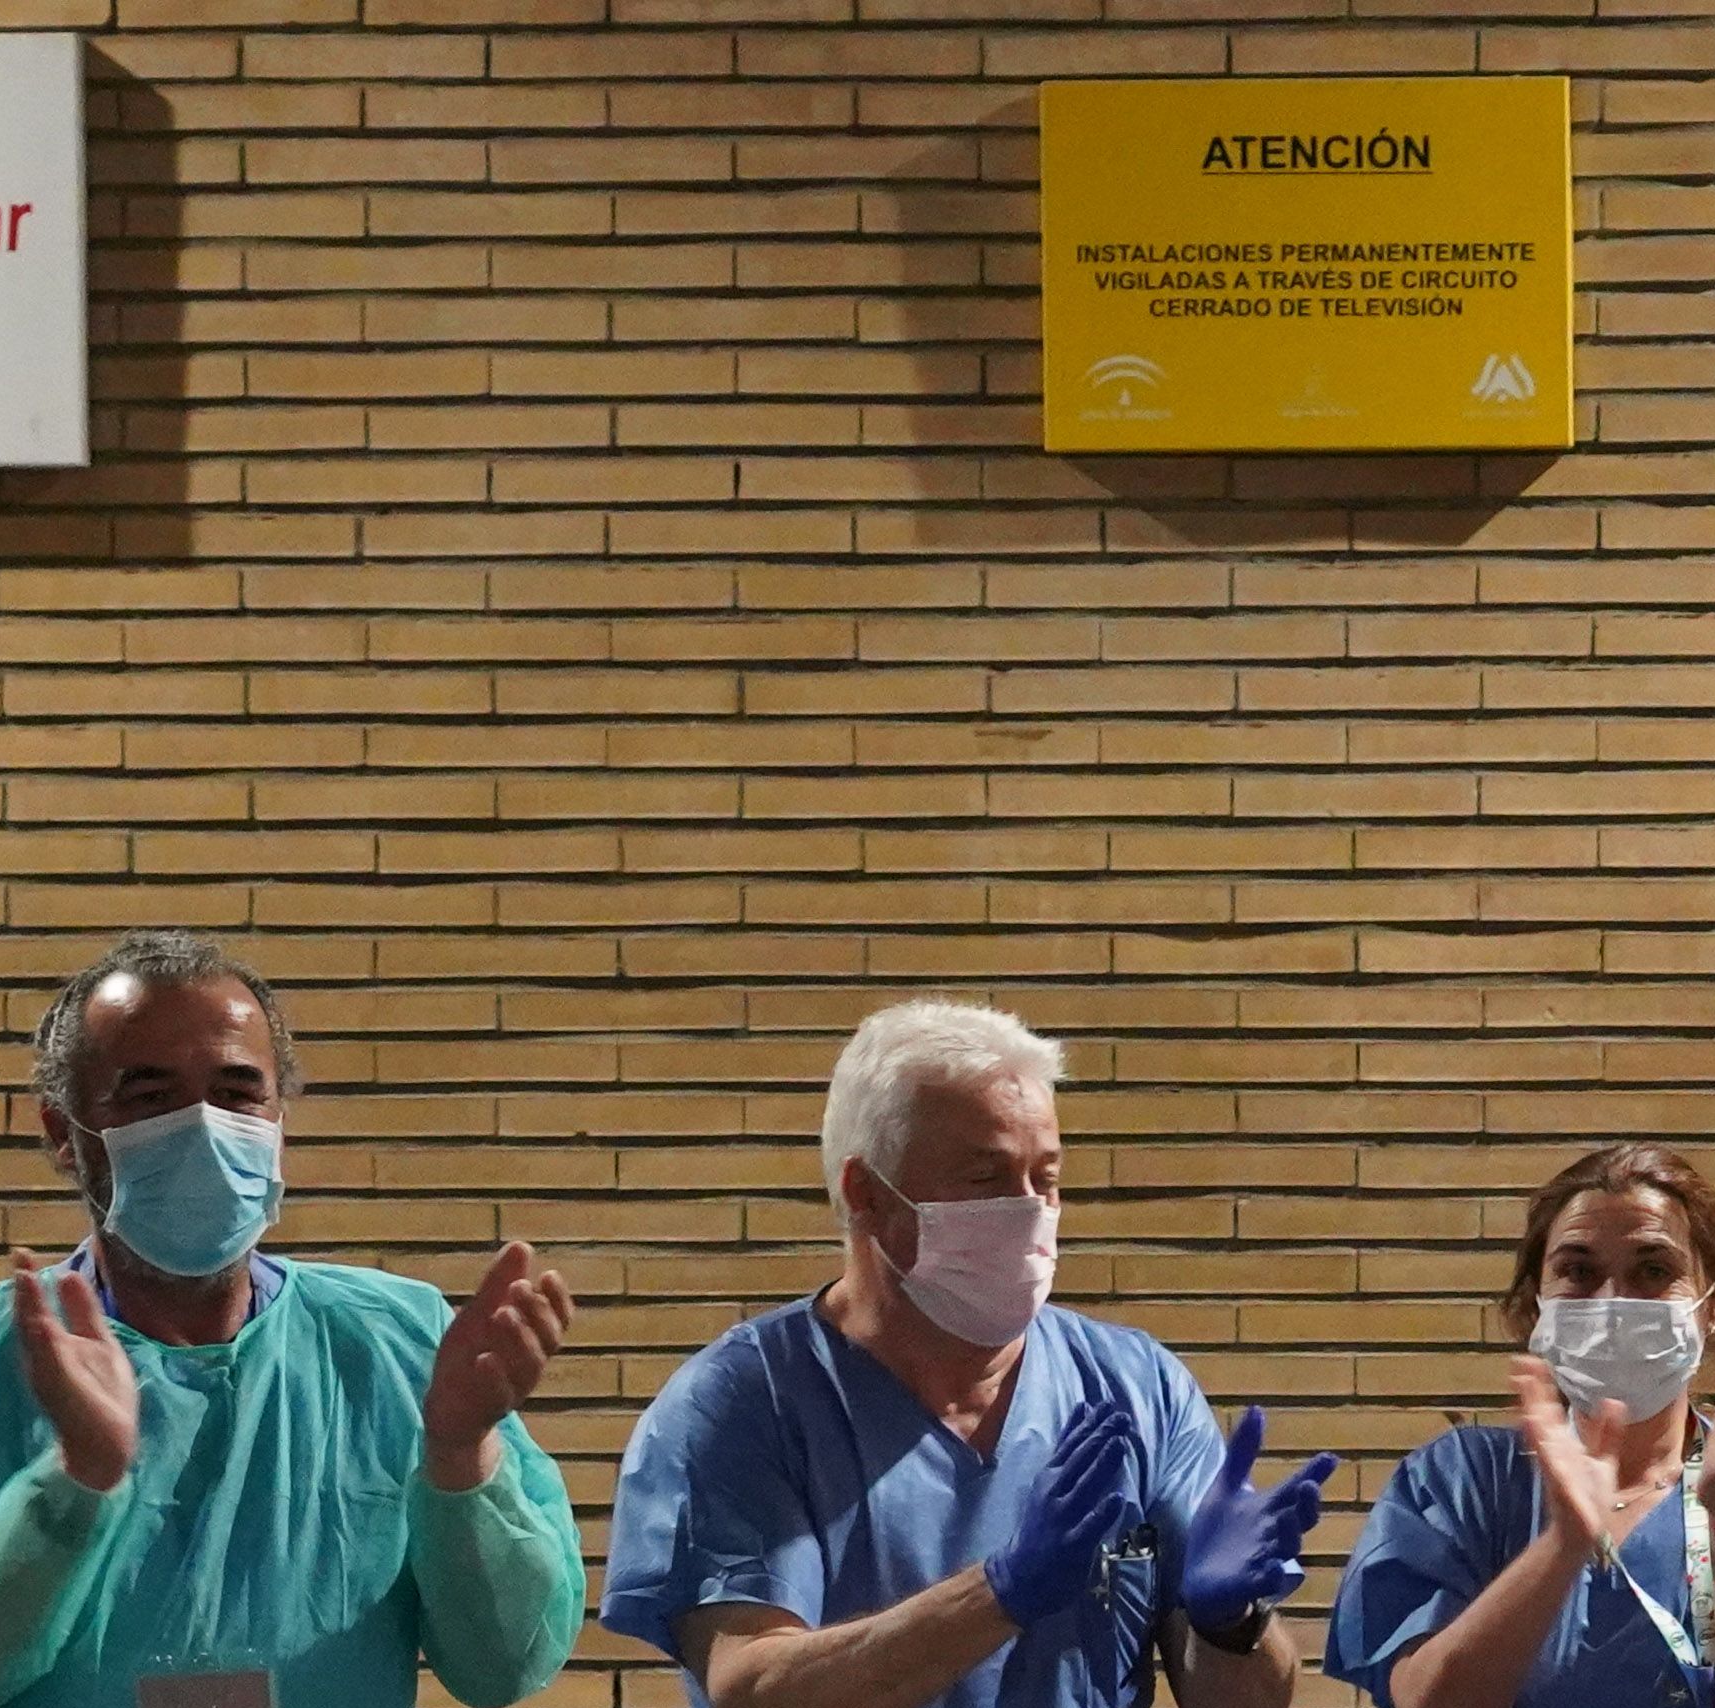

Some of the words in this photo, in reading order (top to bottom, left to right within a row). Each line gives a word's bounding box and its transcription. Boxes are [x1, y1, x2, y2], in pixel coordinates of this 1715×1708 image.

[1202, 127, 1431, 169] ATENCIÓN
[1076, 244, 1274, 264] INSTALACIONES
[1280, 242, 1536, 263] PERMANENTEMENTE
[1094, 271, 1228, 291] VIGILADAS
[1233, 271, 1251, 290] A
[1258, 267, 1353, 291] TRAVÉS
[1360, 270, 1393, 290] DE
[1401, 269, 1518, 290] CIRCUITO
[1149, 297, 1273, 318] CERRADO
[1279, 298, 1313, 318] DE
[1320, 294, 1464, 318] TELEVISIÓN
